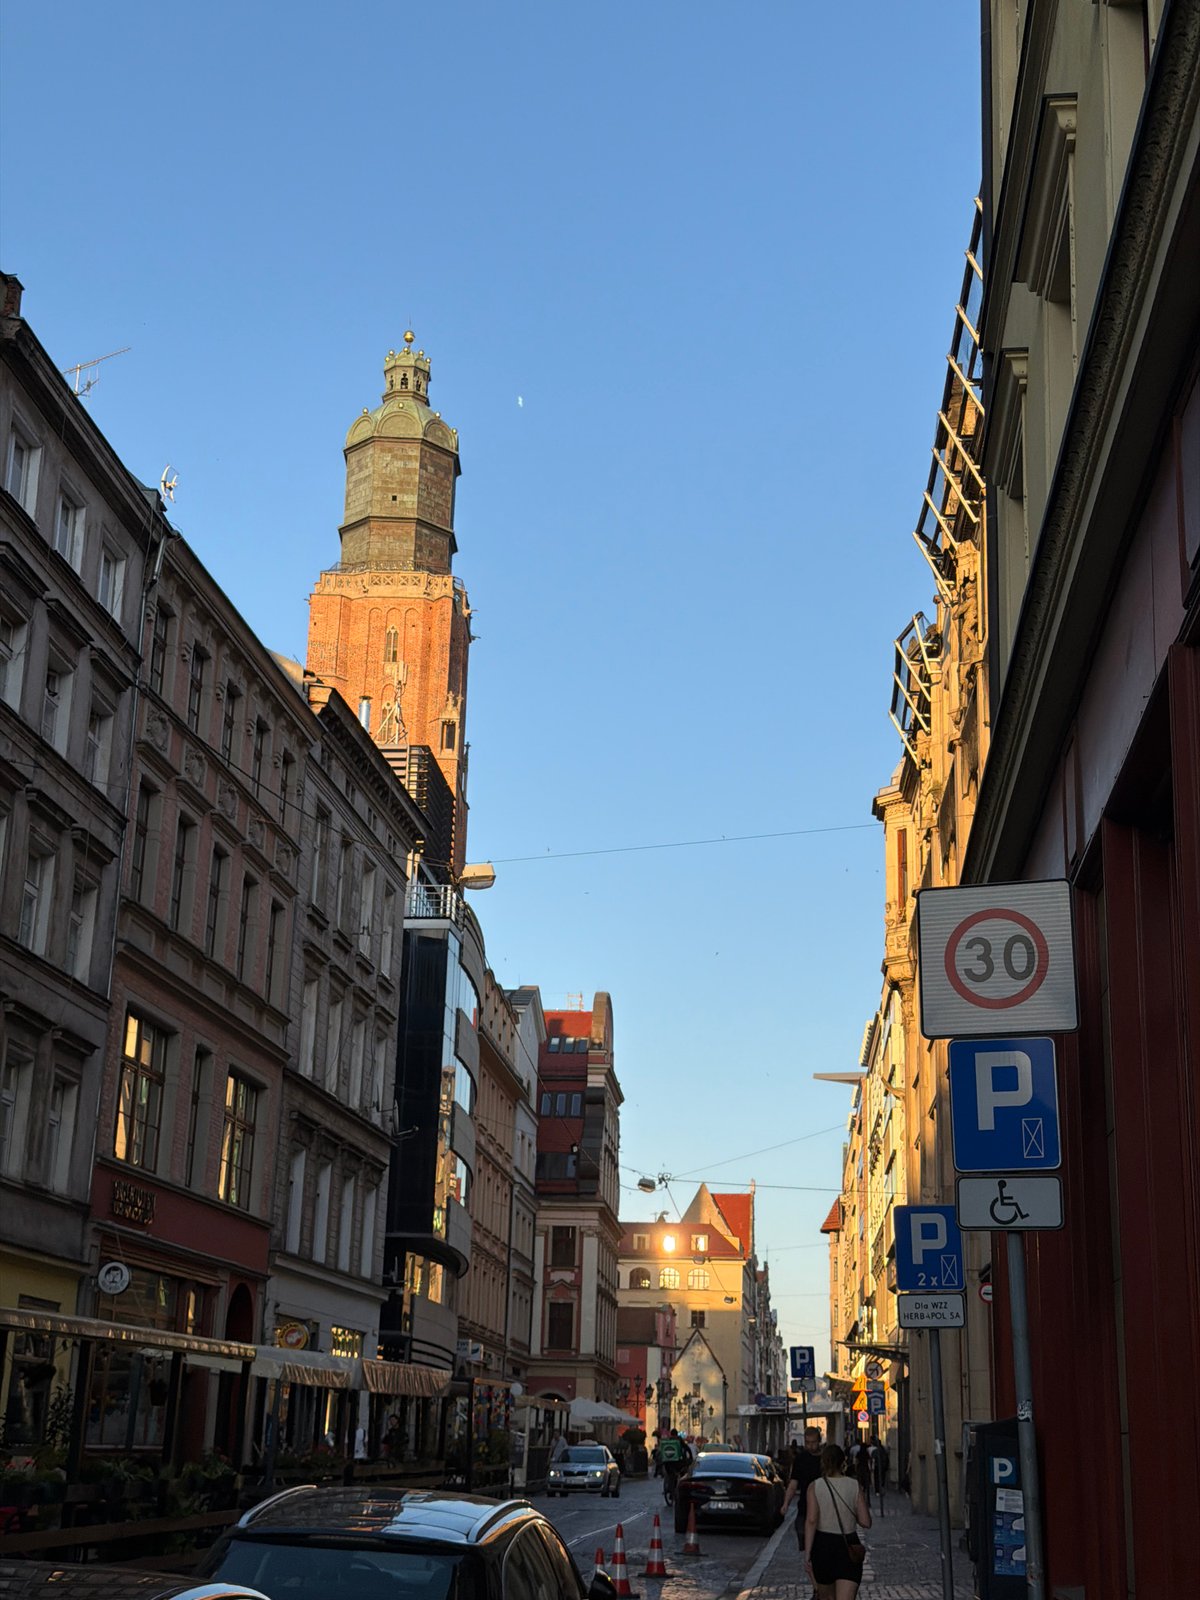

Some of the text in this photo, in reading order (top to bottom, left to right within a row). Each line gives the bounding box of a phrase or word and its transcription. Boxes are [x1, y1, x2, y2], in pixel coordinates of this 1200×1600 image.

[963, 935, 1035, 982] 30
[974, 1051, 1033, 1131] P
[910, 1213, 947, 1265] P
[917, 1272, 926, 1287] 2
[931, 1300, 947, 1310] WZZ
[795, 1349, 809, 1369] P
[993, 1457, 1013, 1484] P
